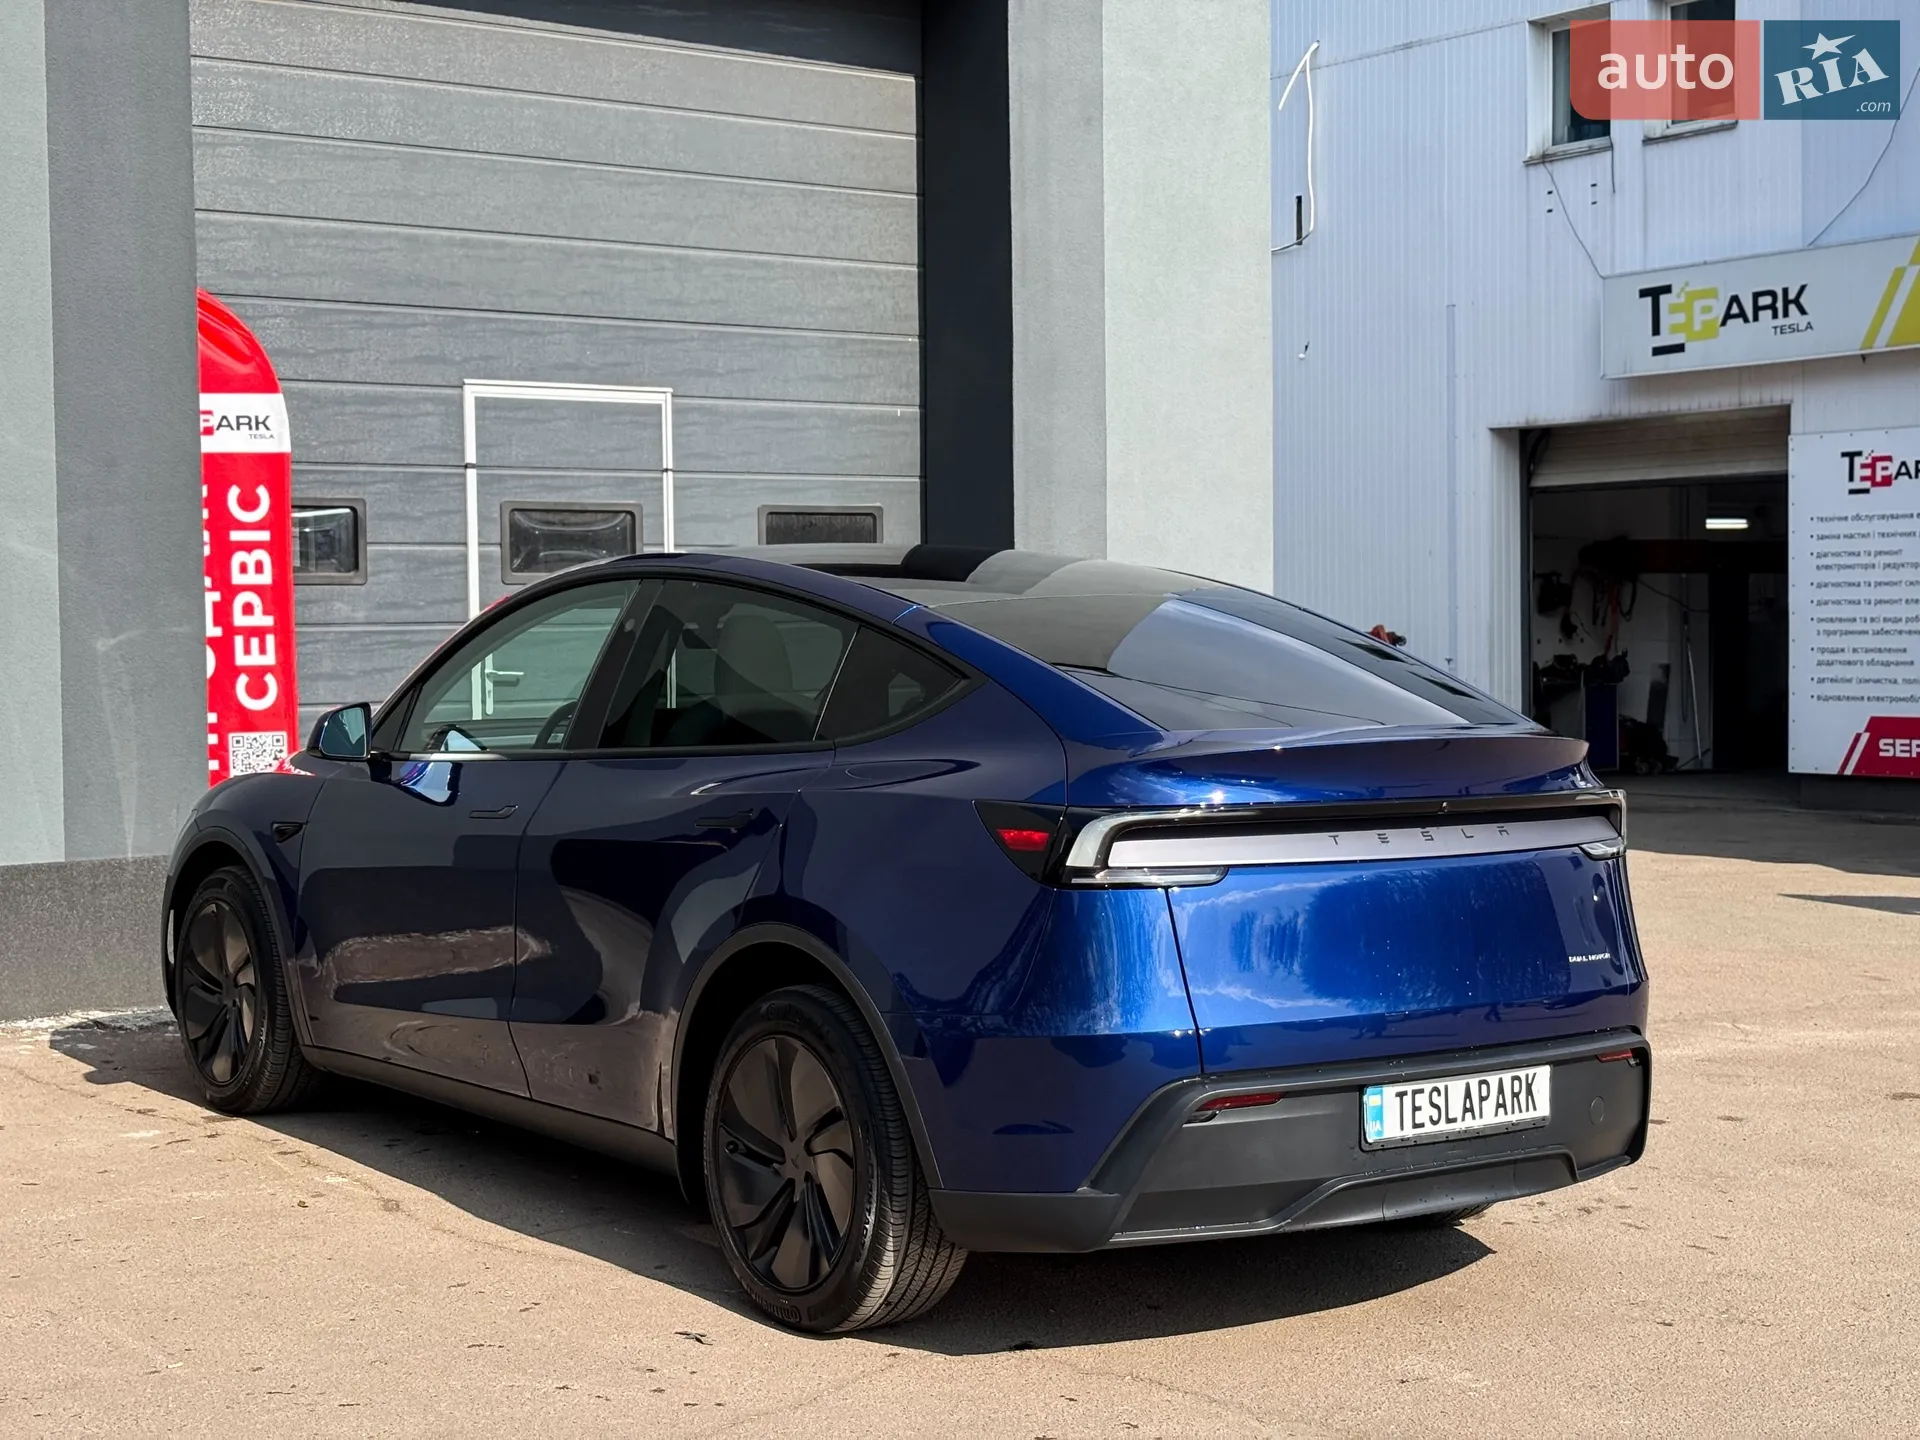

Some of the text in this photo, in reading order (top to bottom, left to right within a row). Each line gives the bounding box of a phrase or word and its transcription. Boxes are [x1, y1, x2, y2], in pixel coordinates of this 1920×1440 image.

[1771, 321, 1814, 335] TESLA
[1851, 513, 1914, 523] обслуговування
[1816, 550, 1861, 559] діагностика
[1874, 549, 1903, 558] ремонт
[1816, 580, 1861, 589] діагностика
[1874, 580, 1903, 589] ремонт
[227, 484, 278, 711] СЕРВІС
[1816, 598, 1861, 606] діагностика
[1874, 598, 1902, 607] ремонт
[1328, 825, 1510, 845] TESLA
[1395, 1072, 1538, 1131] TESLAPARK
